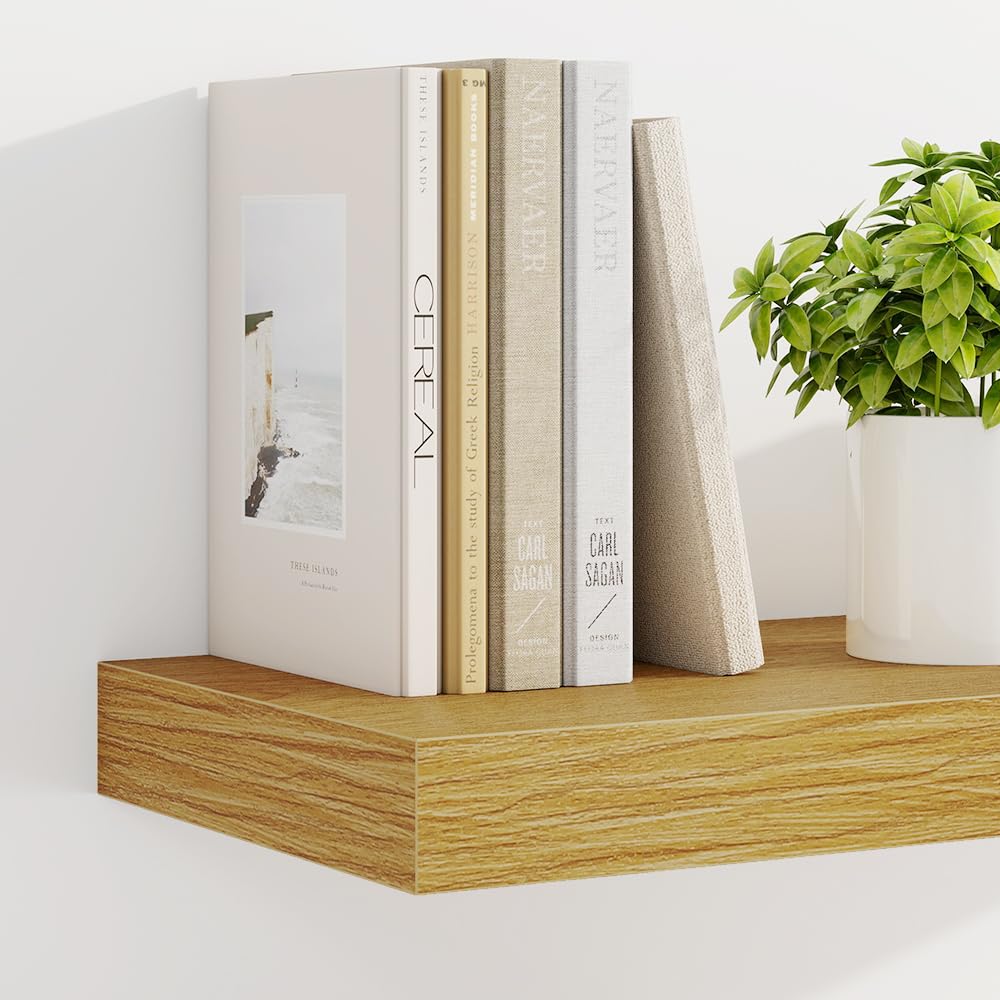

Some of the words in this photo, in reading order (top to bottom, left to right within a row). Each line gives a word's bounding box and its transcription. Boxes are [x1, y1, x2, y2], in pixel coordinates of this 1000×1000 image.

[419, 77, 427, 118] THESE
[419, 131, 427, 193] ISLANDS
[594, 79, 617, 272] NAERVAER
[467, 232, 478, 336] HARRISON
[414, 274, 434, 489] CEREAL
[466, 345, 483, 407] Religion
[466, 415, 478, 460] Greek
[466, 466, 477, 482] of
[465, 490, 482, 528] study
[595, 517, 614, 525] TEXT
[465, 535, 477, 558] the
[518, 534, 546, 561] CARL
[590, 531, 619, 558] CARL
[468, 565, 477, 580] to
[513, 563, 553, 591] SAGAN
[585, 560, 624, 588] SAGAN
[465, 589, 482, 684] Prolegomena
